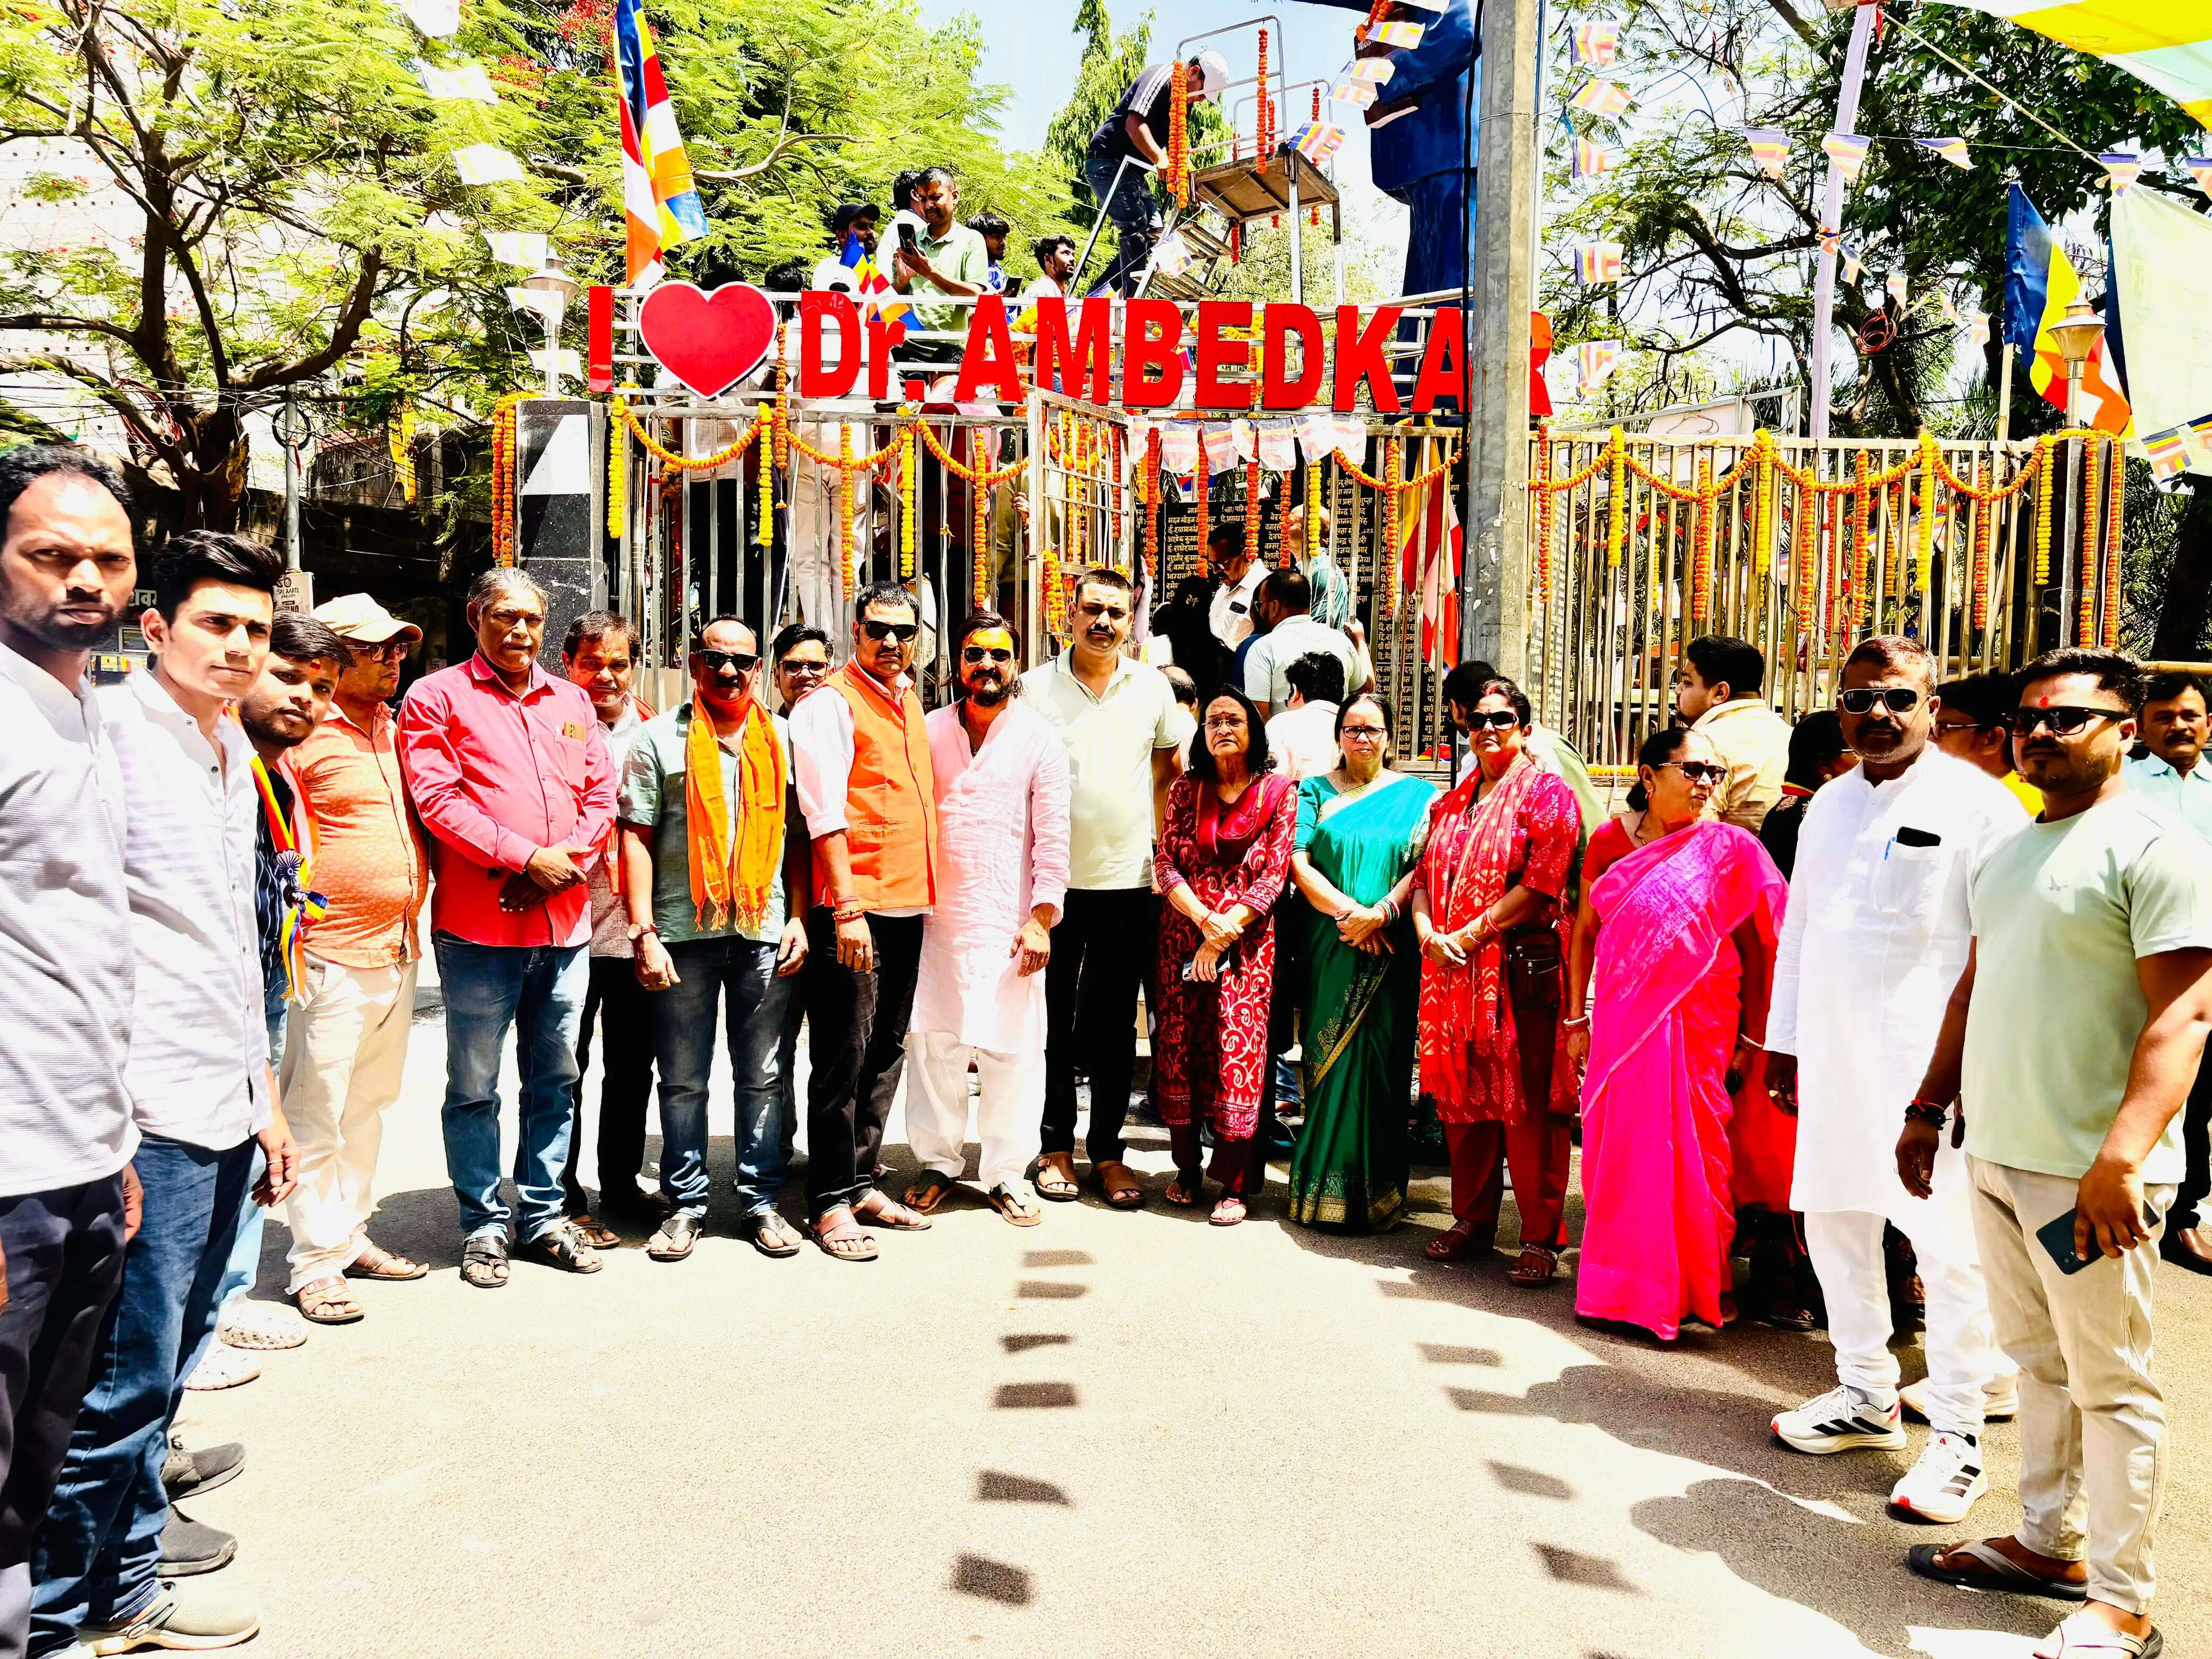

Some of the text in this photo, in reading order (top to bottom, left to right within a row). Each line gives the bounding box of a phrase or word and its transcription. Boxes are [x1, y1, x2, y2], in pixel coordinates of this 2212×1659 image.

[589, 286, 613, 392] I
[801, 291, 925, 401] Dr.
[1401, 715, 1412, 724] ठाकु
